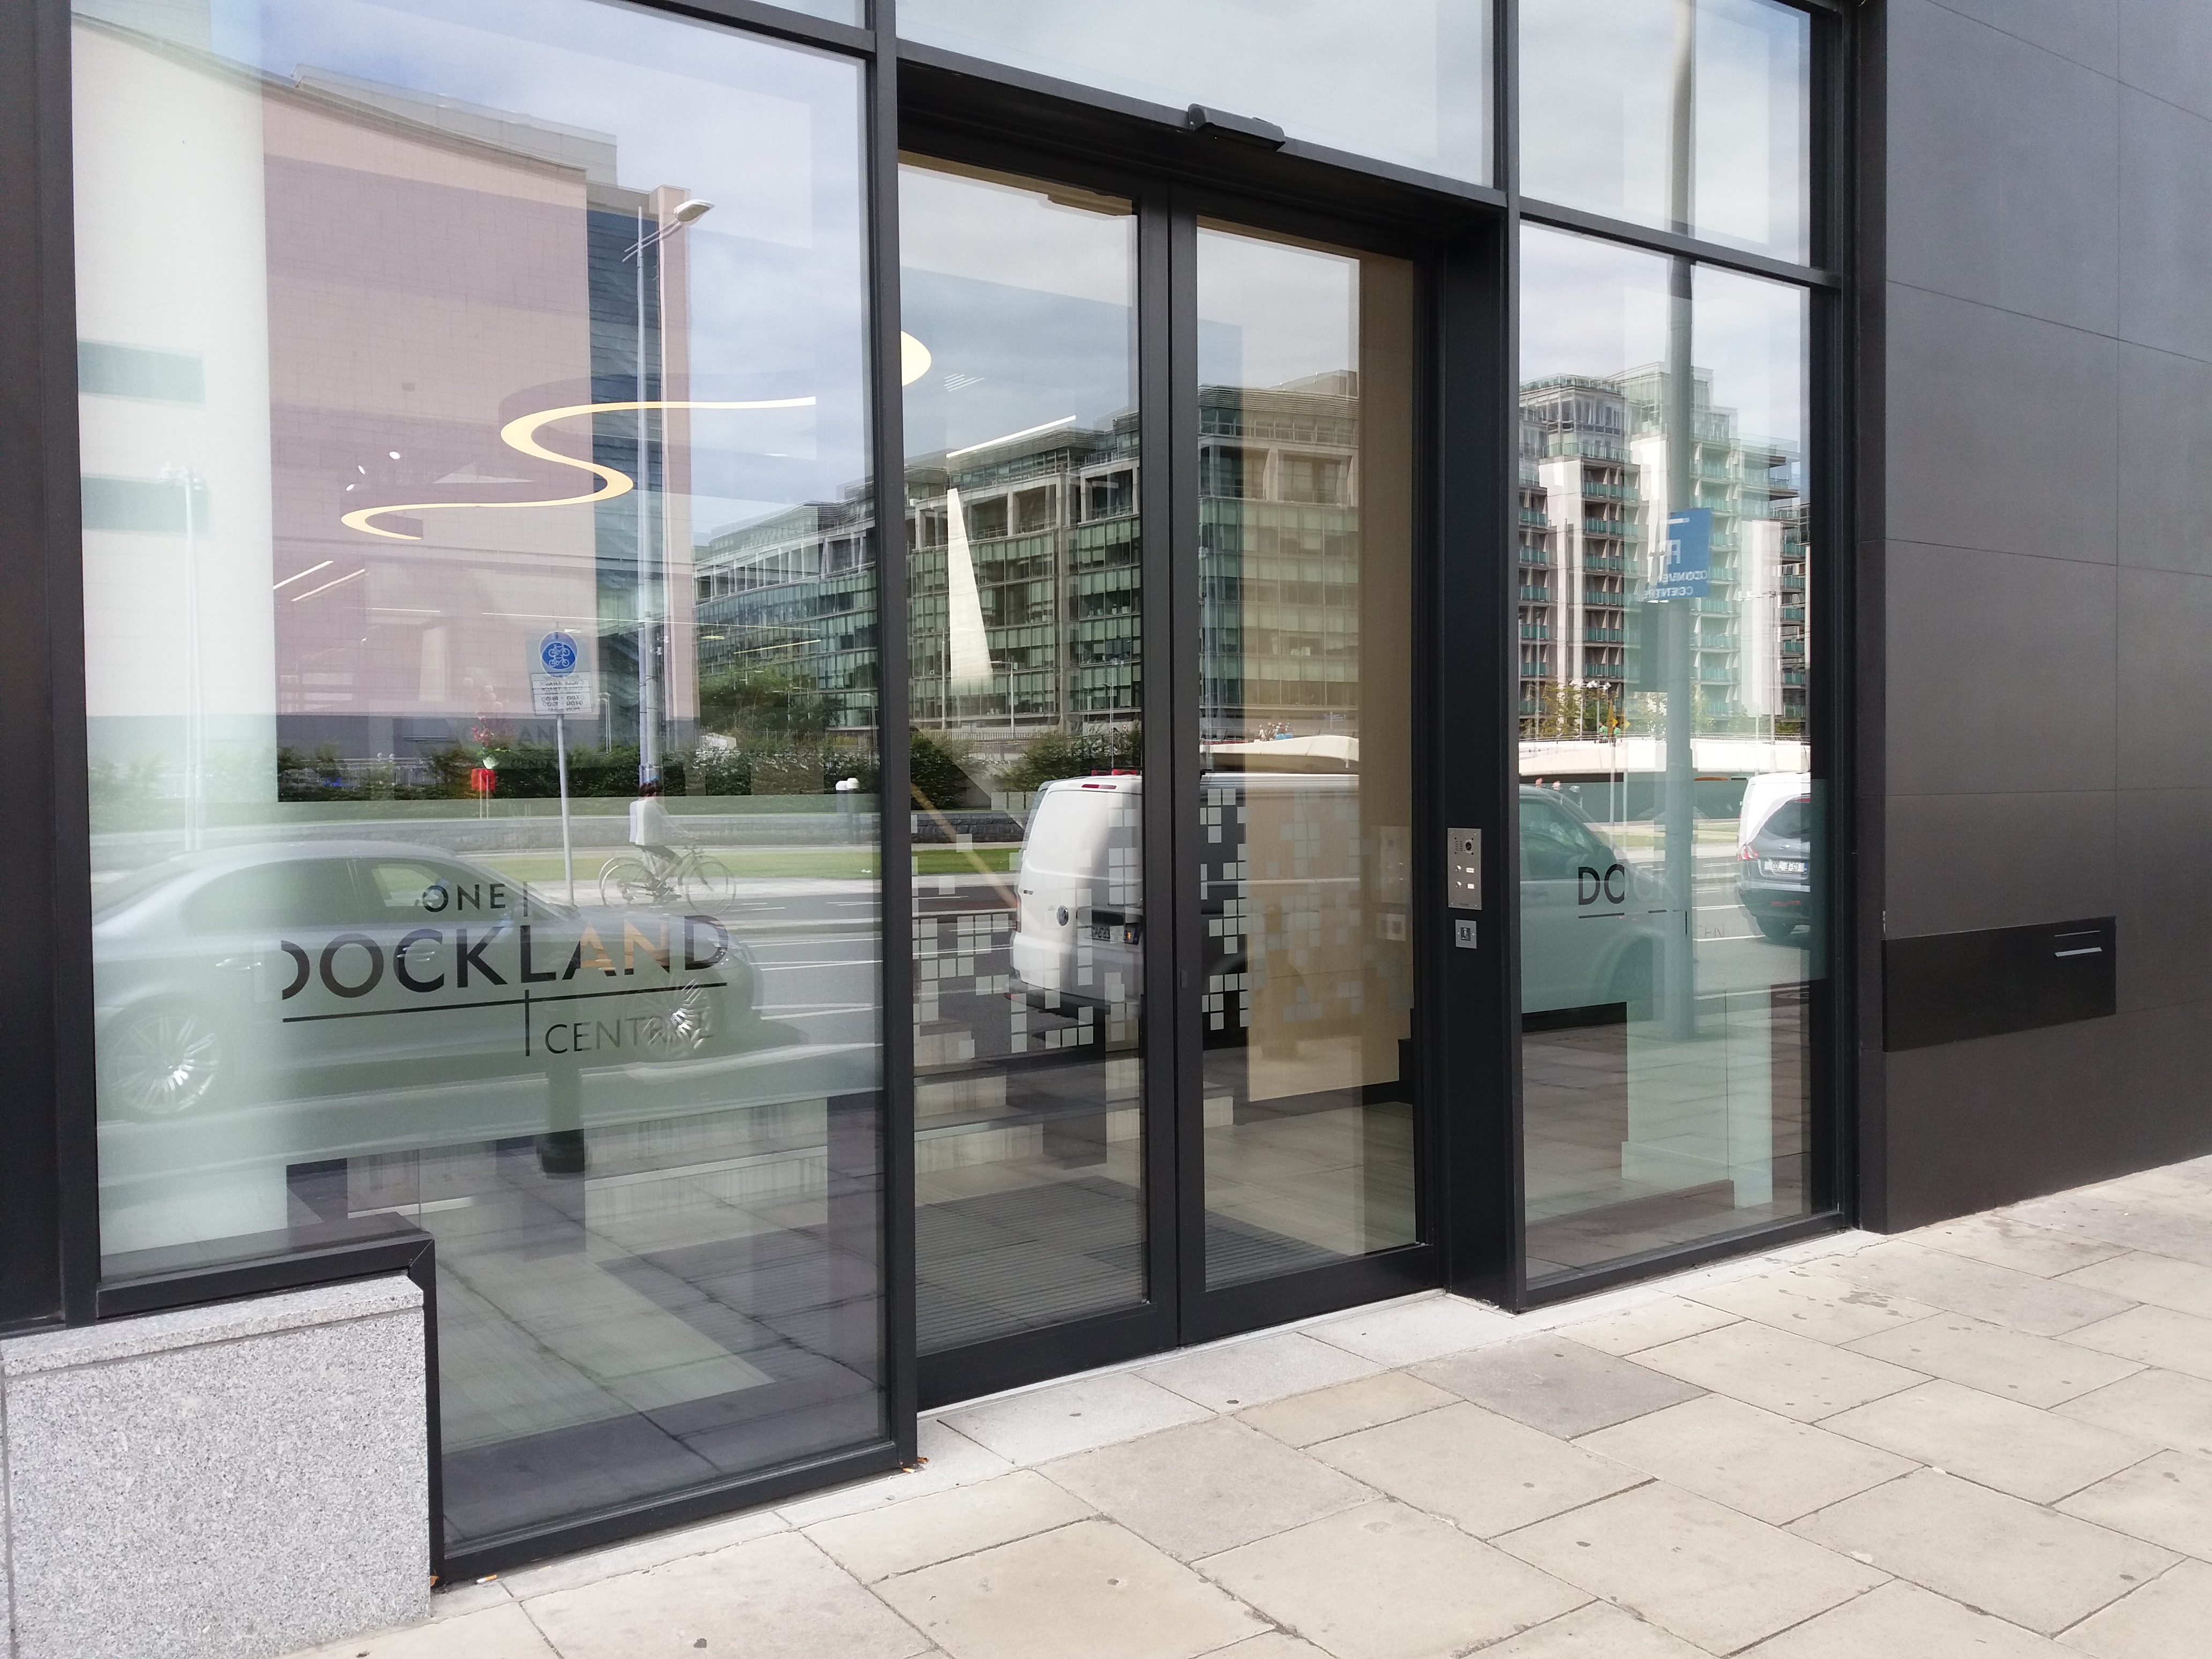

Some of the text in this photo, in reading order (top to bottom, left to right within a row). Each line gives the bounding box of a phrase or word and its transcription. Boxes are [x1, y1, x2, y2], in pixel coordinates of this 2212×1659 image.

[422, 883, 506, 913] ONE
[281, 915, 729, 1000] DOCKLAND
[544, 1011, 715, 1054] CENTRL
